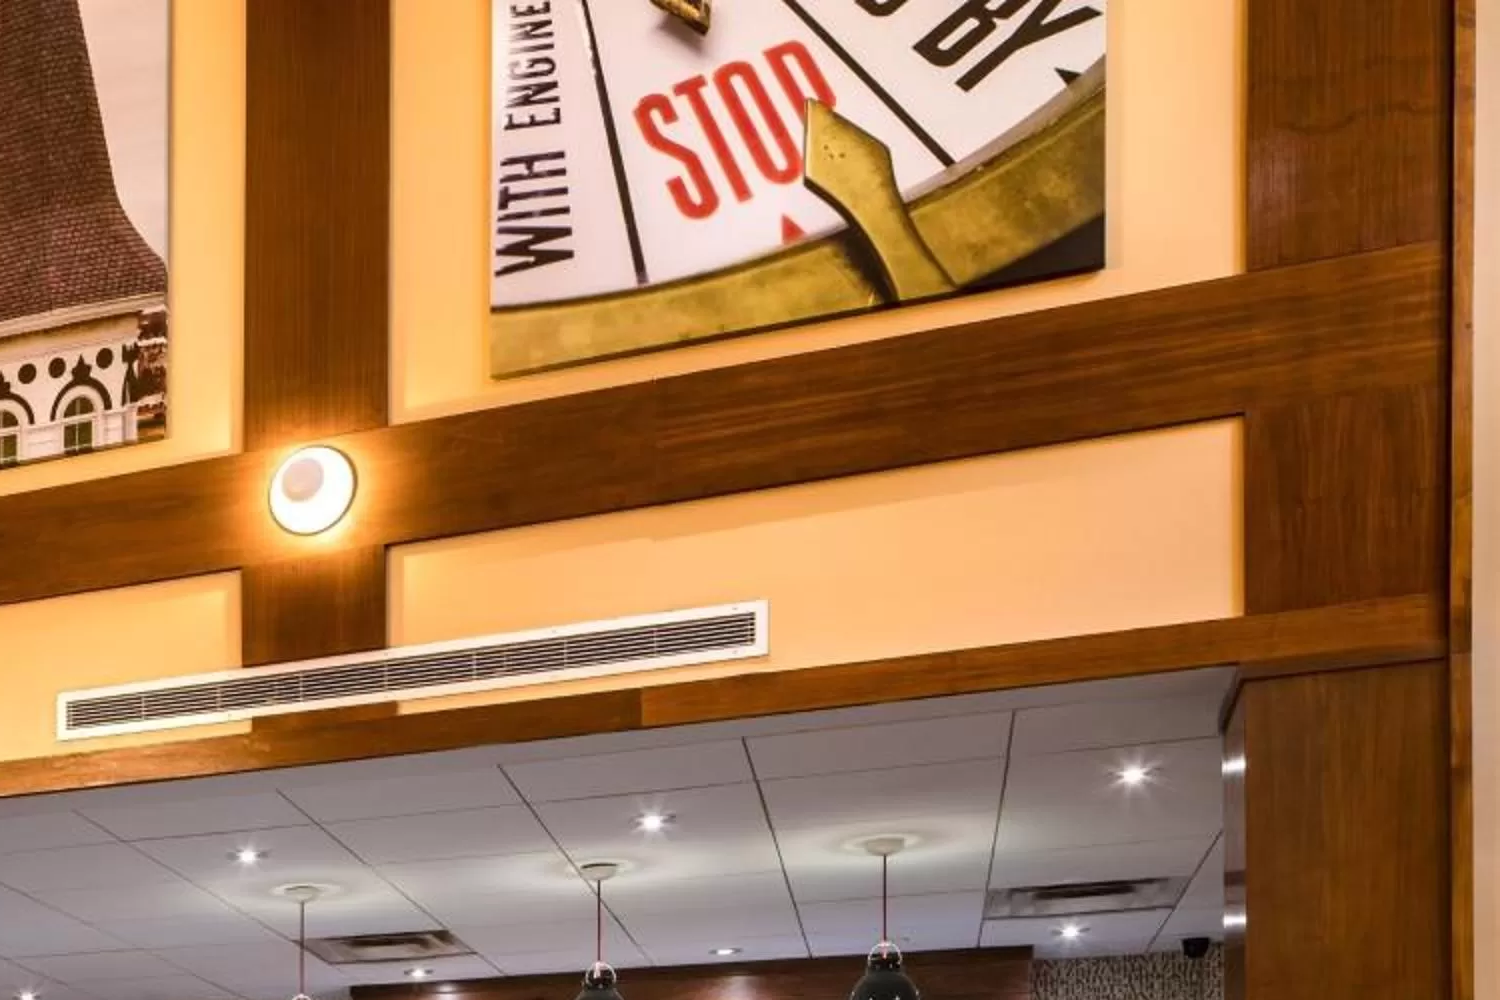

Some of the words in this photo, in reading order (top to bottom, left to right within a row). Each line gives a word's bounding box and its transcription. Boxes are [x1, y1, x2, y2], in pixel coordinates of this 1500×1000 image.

[503, 1, 562, 131] ENGINE
[911, 0, 1103, 92] BY
[494, 150, 575, 277] WITH
